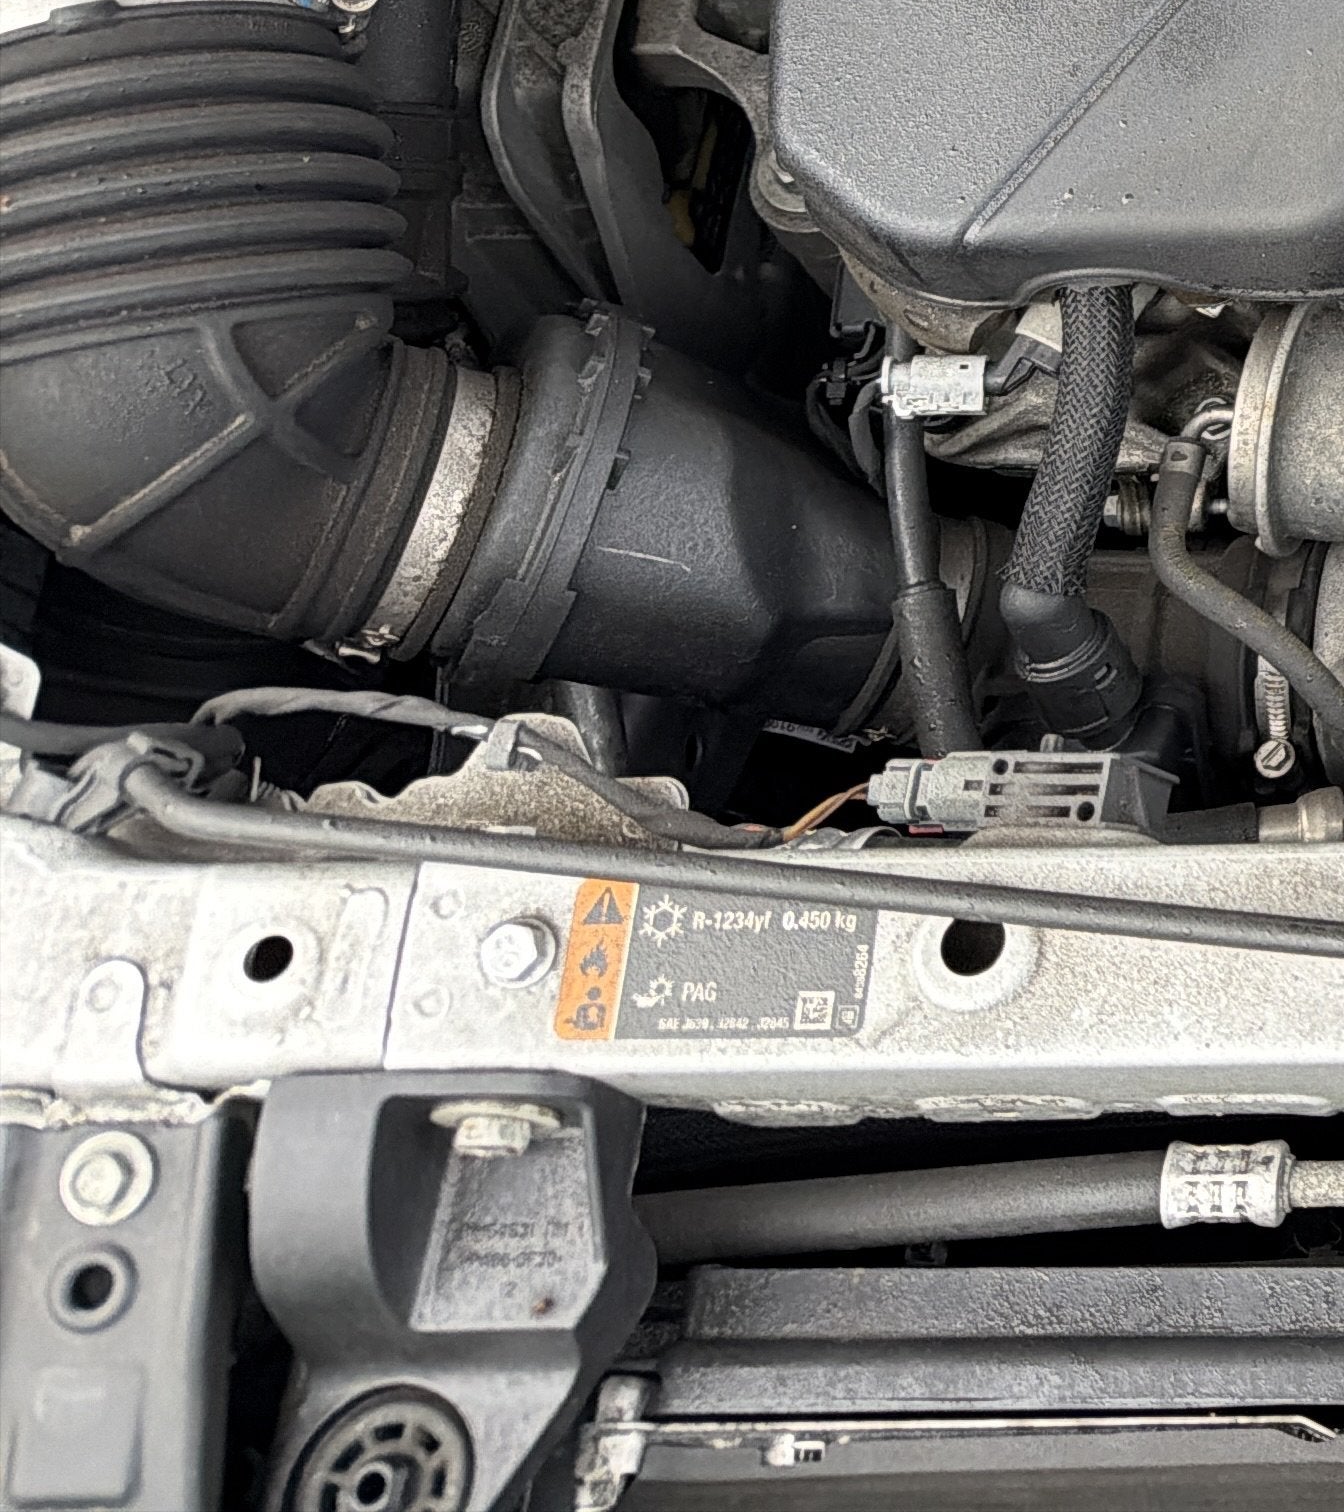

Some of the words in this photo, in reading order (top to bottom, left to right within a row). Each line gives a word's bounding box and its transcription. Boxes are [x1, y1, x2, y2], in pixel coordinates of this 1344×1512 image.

[692, 911, 772, 934] R-1234yf
[782, 910, 832, 931] 0.450
[834, 911, 858, 933] kg
[680, 981, 718, 1003] PAG
